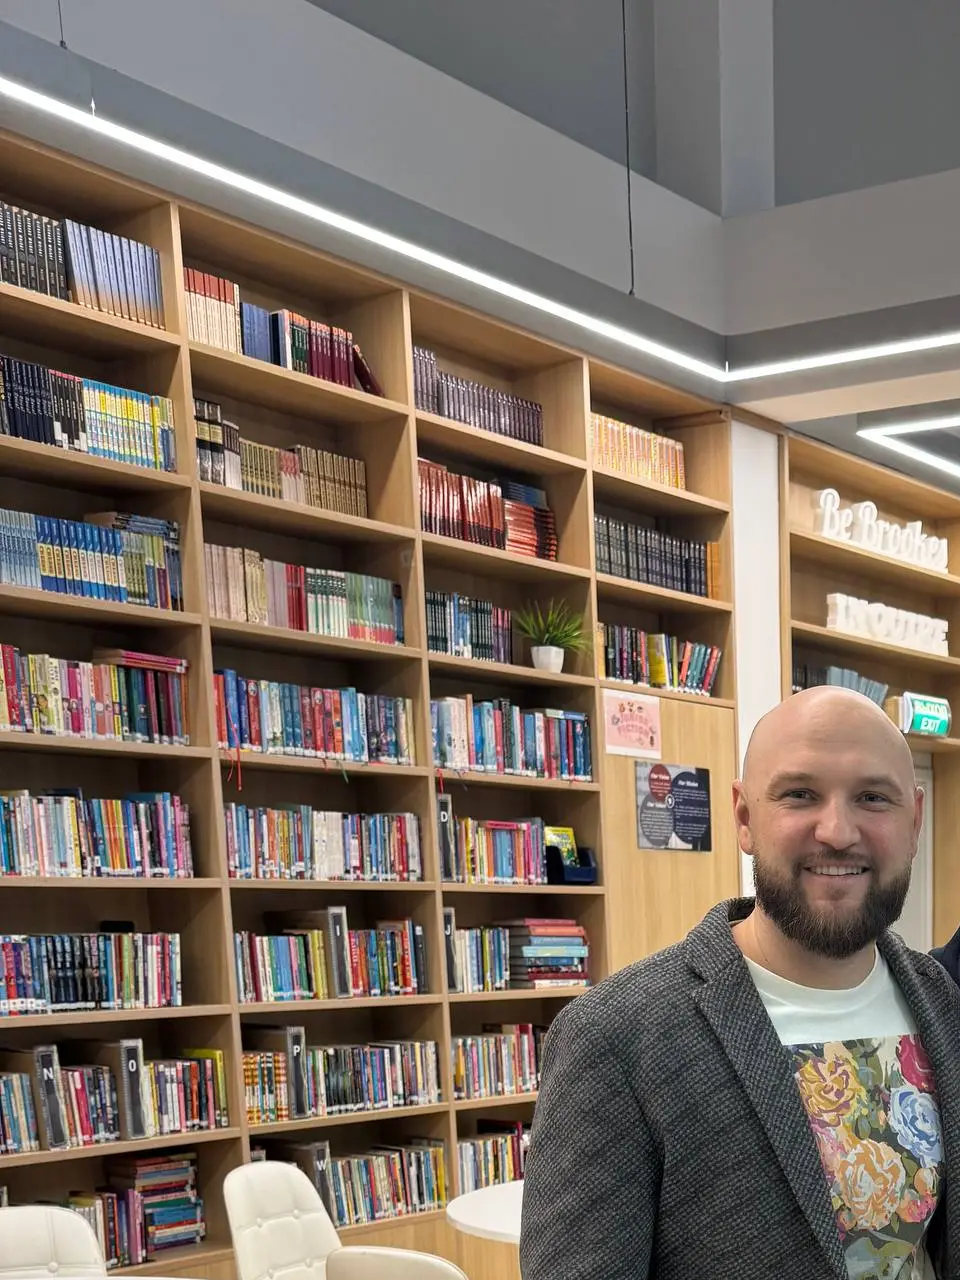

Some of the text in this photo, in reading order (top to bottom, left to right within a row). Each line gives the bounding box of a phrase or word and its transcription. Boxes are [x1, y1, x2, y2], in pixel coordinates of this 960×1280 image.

[820, 488, 949, 572] Be Brookes
[920, 716, 941, 733] EXIT
[440, 811, 449, 823] D
[336, 924, 341, 937] I
[444, 924, 451, 936] J
[293, 1044, 301, 1057] P
[43, 1067, 54, 1080] N
[316, 1158, 327, 1171] W
